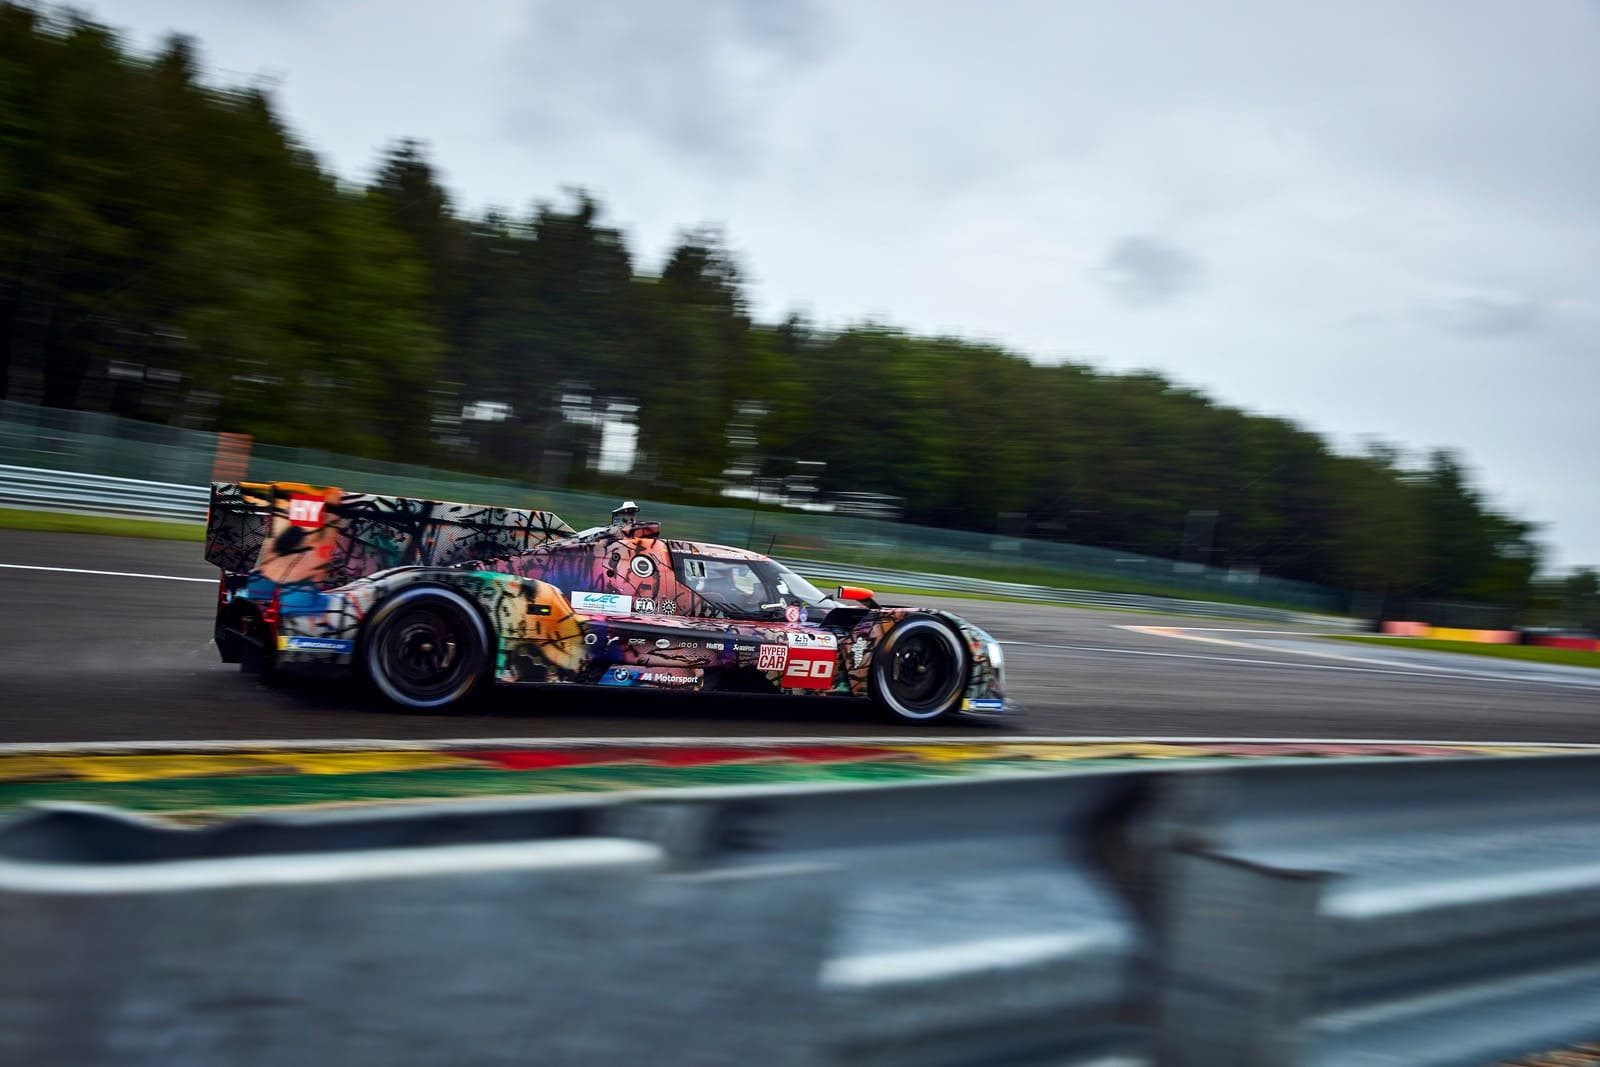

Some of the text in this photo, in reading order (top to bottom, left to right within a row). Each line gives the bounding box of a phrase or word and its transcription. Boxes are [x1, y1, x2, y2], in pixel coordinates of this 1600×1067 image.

[289, 499, 325, 521] HY
[584, 594, 620, 604] WEC
[636, 599, 654, 612] FIA
[761, 646, 786, 656] HYPER
[760, 656, 785, 668] CAR
[786, 659, 834, 678] 20
[655, 674, 698, 684] Motorsport
